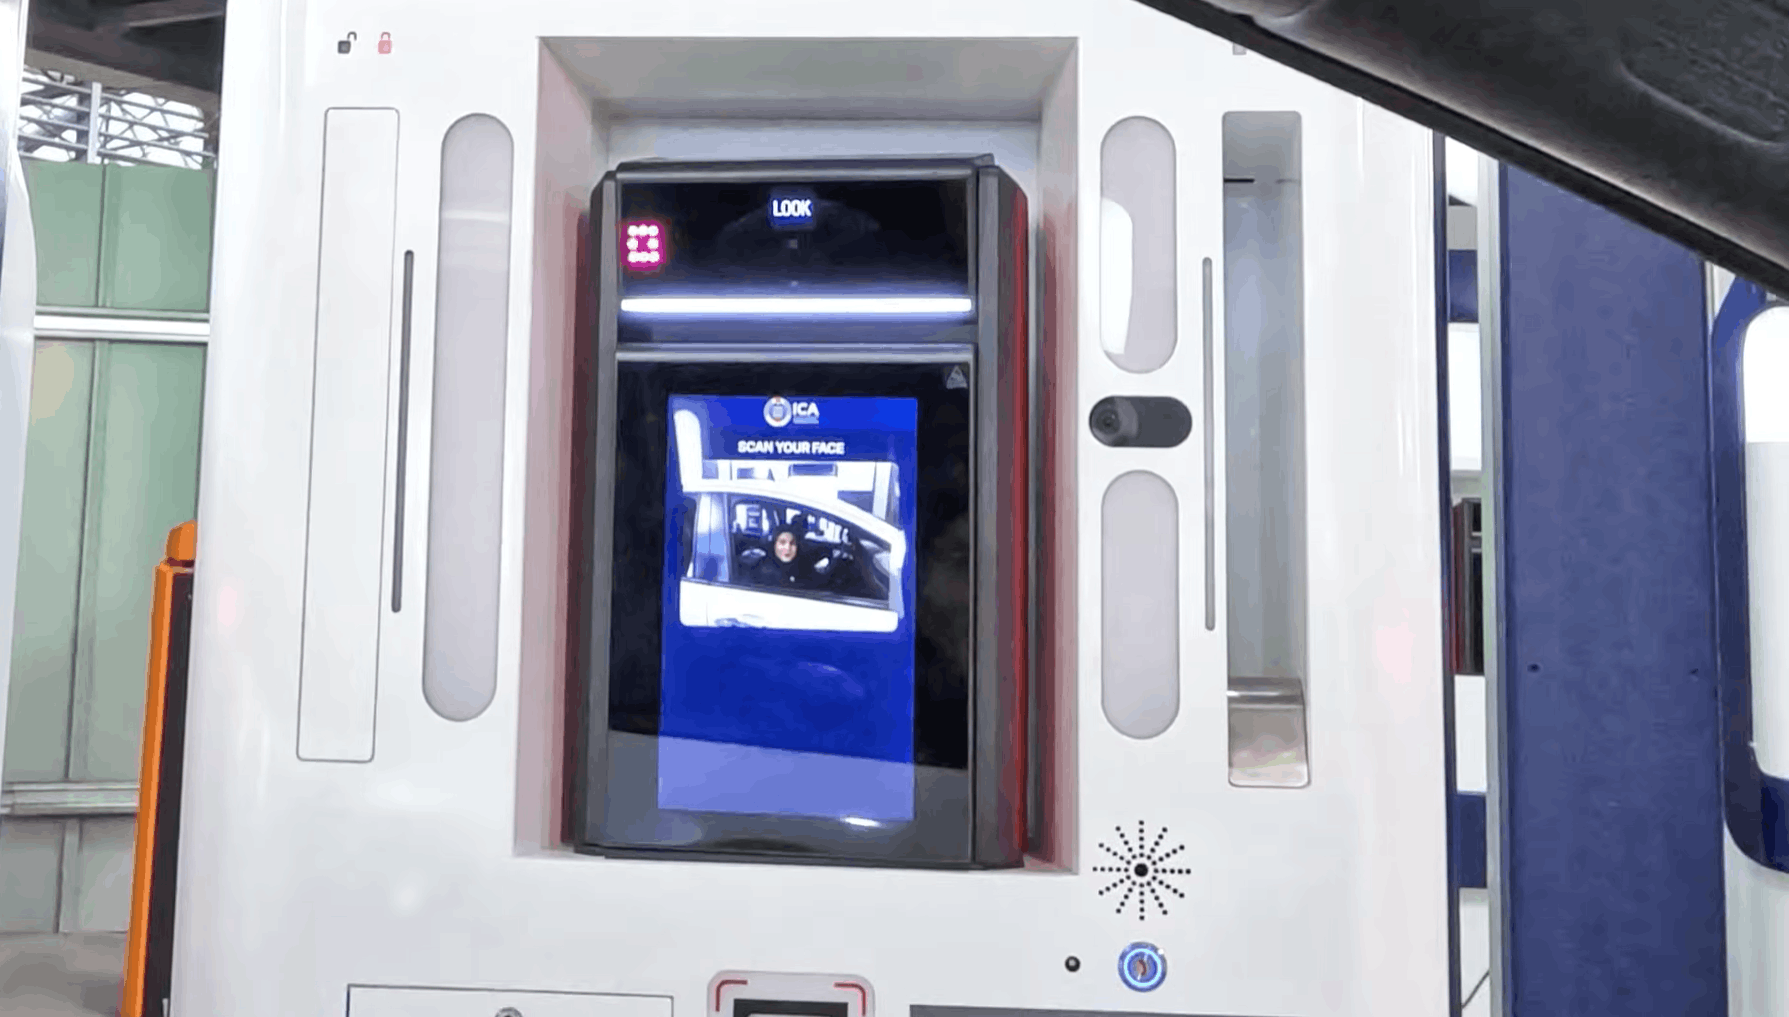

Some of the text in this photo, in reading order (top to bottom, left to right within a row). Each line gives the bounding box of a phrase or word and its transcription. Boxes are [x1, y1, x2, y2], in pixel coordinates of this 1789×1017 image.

[773, 199, 812, 217] LOOK
[792, 402, 820, 416] ICA
[737, 440, 845, 456] SCAN YOUR FACE
